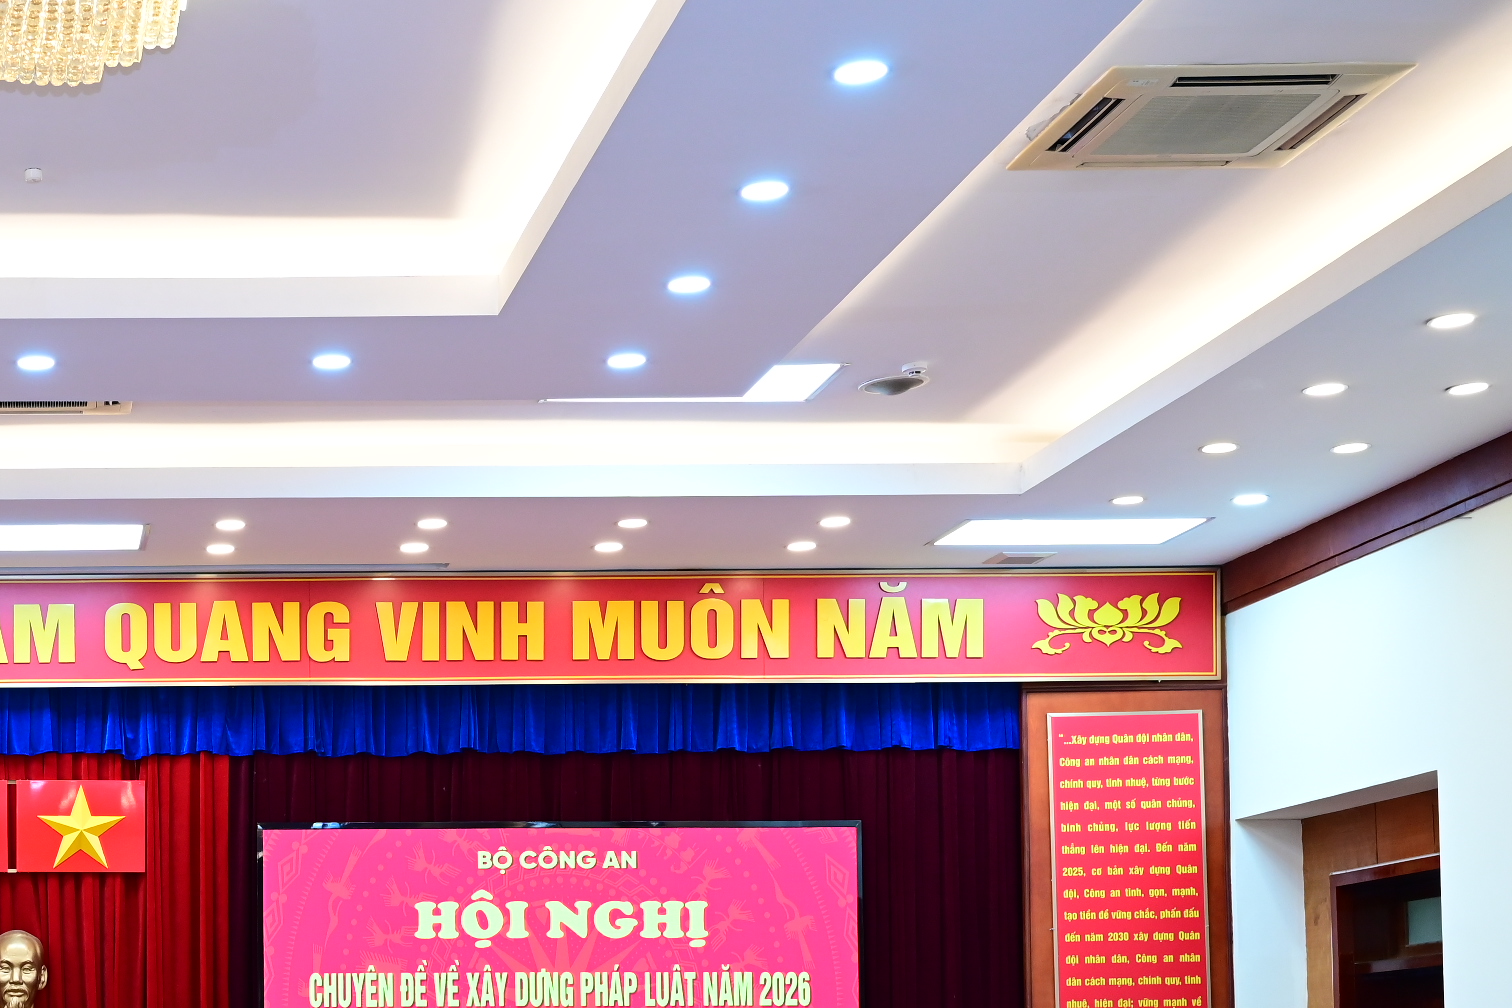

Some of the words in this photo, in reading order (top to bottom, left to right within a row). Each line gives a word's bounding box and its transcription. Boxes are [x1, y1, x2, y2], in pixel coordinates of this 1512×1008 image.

[104, 600, 350, 670] QUANG
[376, 601, 544, 661] VINH
[572, 584, 789, 660] MUÔN
[817, 582, 984, 658] NĂM
[1060, 757, 1080, 767] Công
[1099, 756, 1119, 765] nhân
[1124, 756, 1139, 764] dân
[1143, 755, 1163, 764] cách
[1168, 756, 1193, 765] mạng,
[477, 845, 514, 875] BỘ
[519, 845, 597, 869] CÔNG
[602, 850, 638, 869] AN
[1063, 867, 1086, 876] 2025,
[1108, 865, 1123, 875] bản
[1129, 866, 1144, 875] xây
[1150, 866, 1170, 876] dựng
[1176, 865, 1197, 874] Quân
[414, 889, 530, 949] HỘI
[545, 900, 709, 948] NGHỊ
[1065, 932, 1080, 942] đến
[1085, 933, 1103, 941] năm
[1108, 932, 1129, 941] 2030
[1134, 932, 1148, 941] xây
[1153, 932, 1174, 941] dựng
[1179, 931, 1200, 941] Quân
[1066, 955, 1079, 966] đội
[1085, 955, 1105, 963] nhân
[1112, 954, 1129, 964] dân,
[1136, 954, 1157, 963] Công
[1180, 953, 1200, 962] nhân
[308, 964, 395, 1008] CHUYÊN
[400, 959, 428, 1008] ĐỀ
[434, 959, 460, 1008] VỀ
[466, 964, 508, 1008] XÂY
[580, 964, 639, 1007] PHÁP
[702, 965, 754, 1007] NĂM
[759, 971, 812, 1007] 2026
